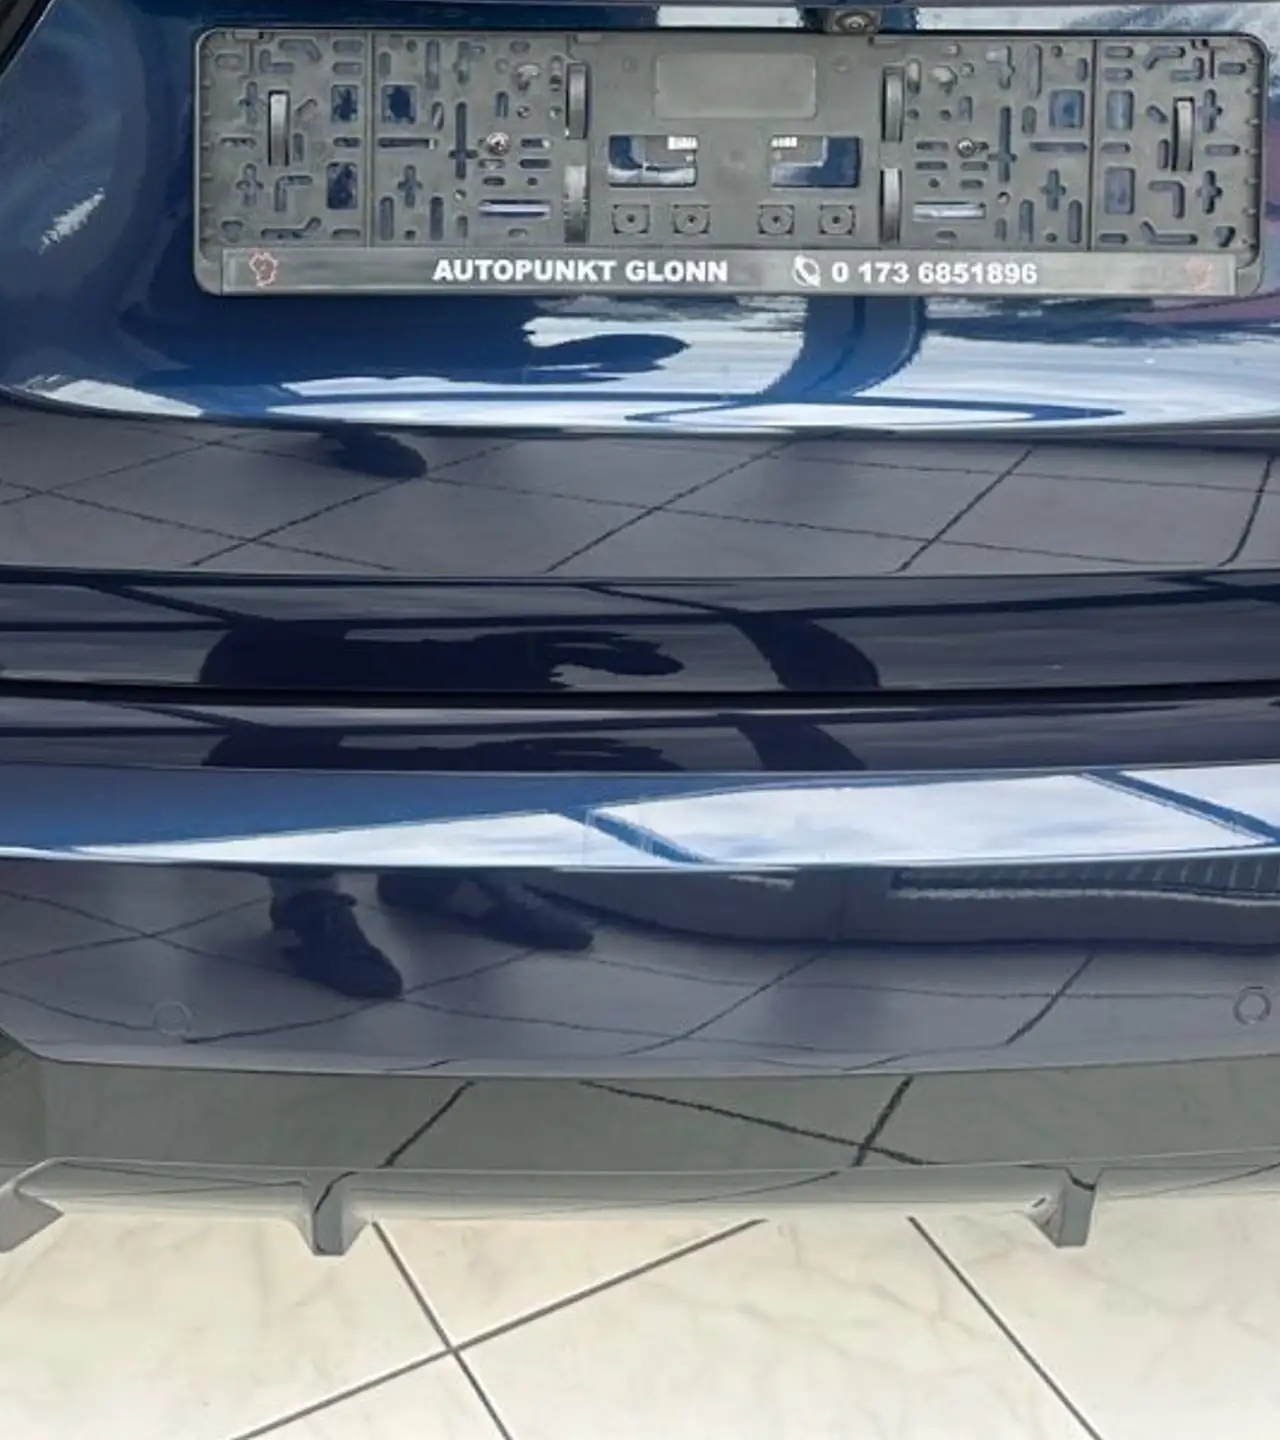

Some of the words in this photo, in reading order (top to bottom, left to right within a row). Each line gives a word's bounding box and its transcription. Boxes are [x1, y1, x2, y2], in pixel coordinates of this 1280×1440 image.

[431, 259, 618, 284] AUTOPUNKT
[624, 259, 729, 283] GLONN
[857, 262, 911, 284] 173
[917, 262, 1038, 284] 6851896
